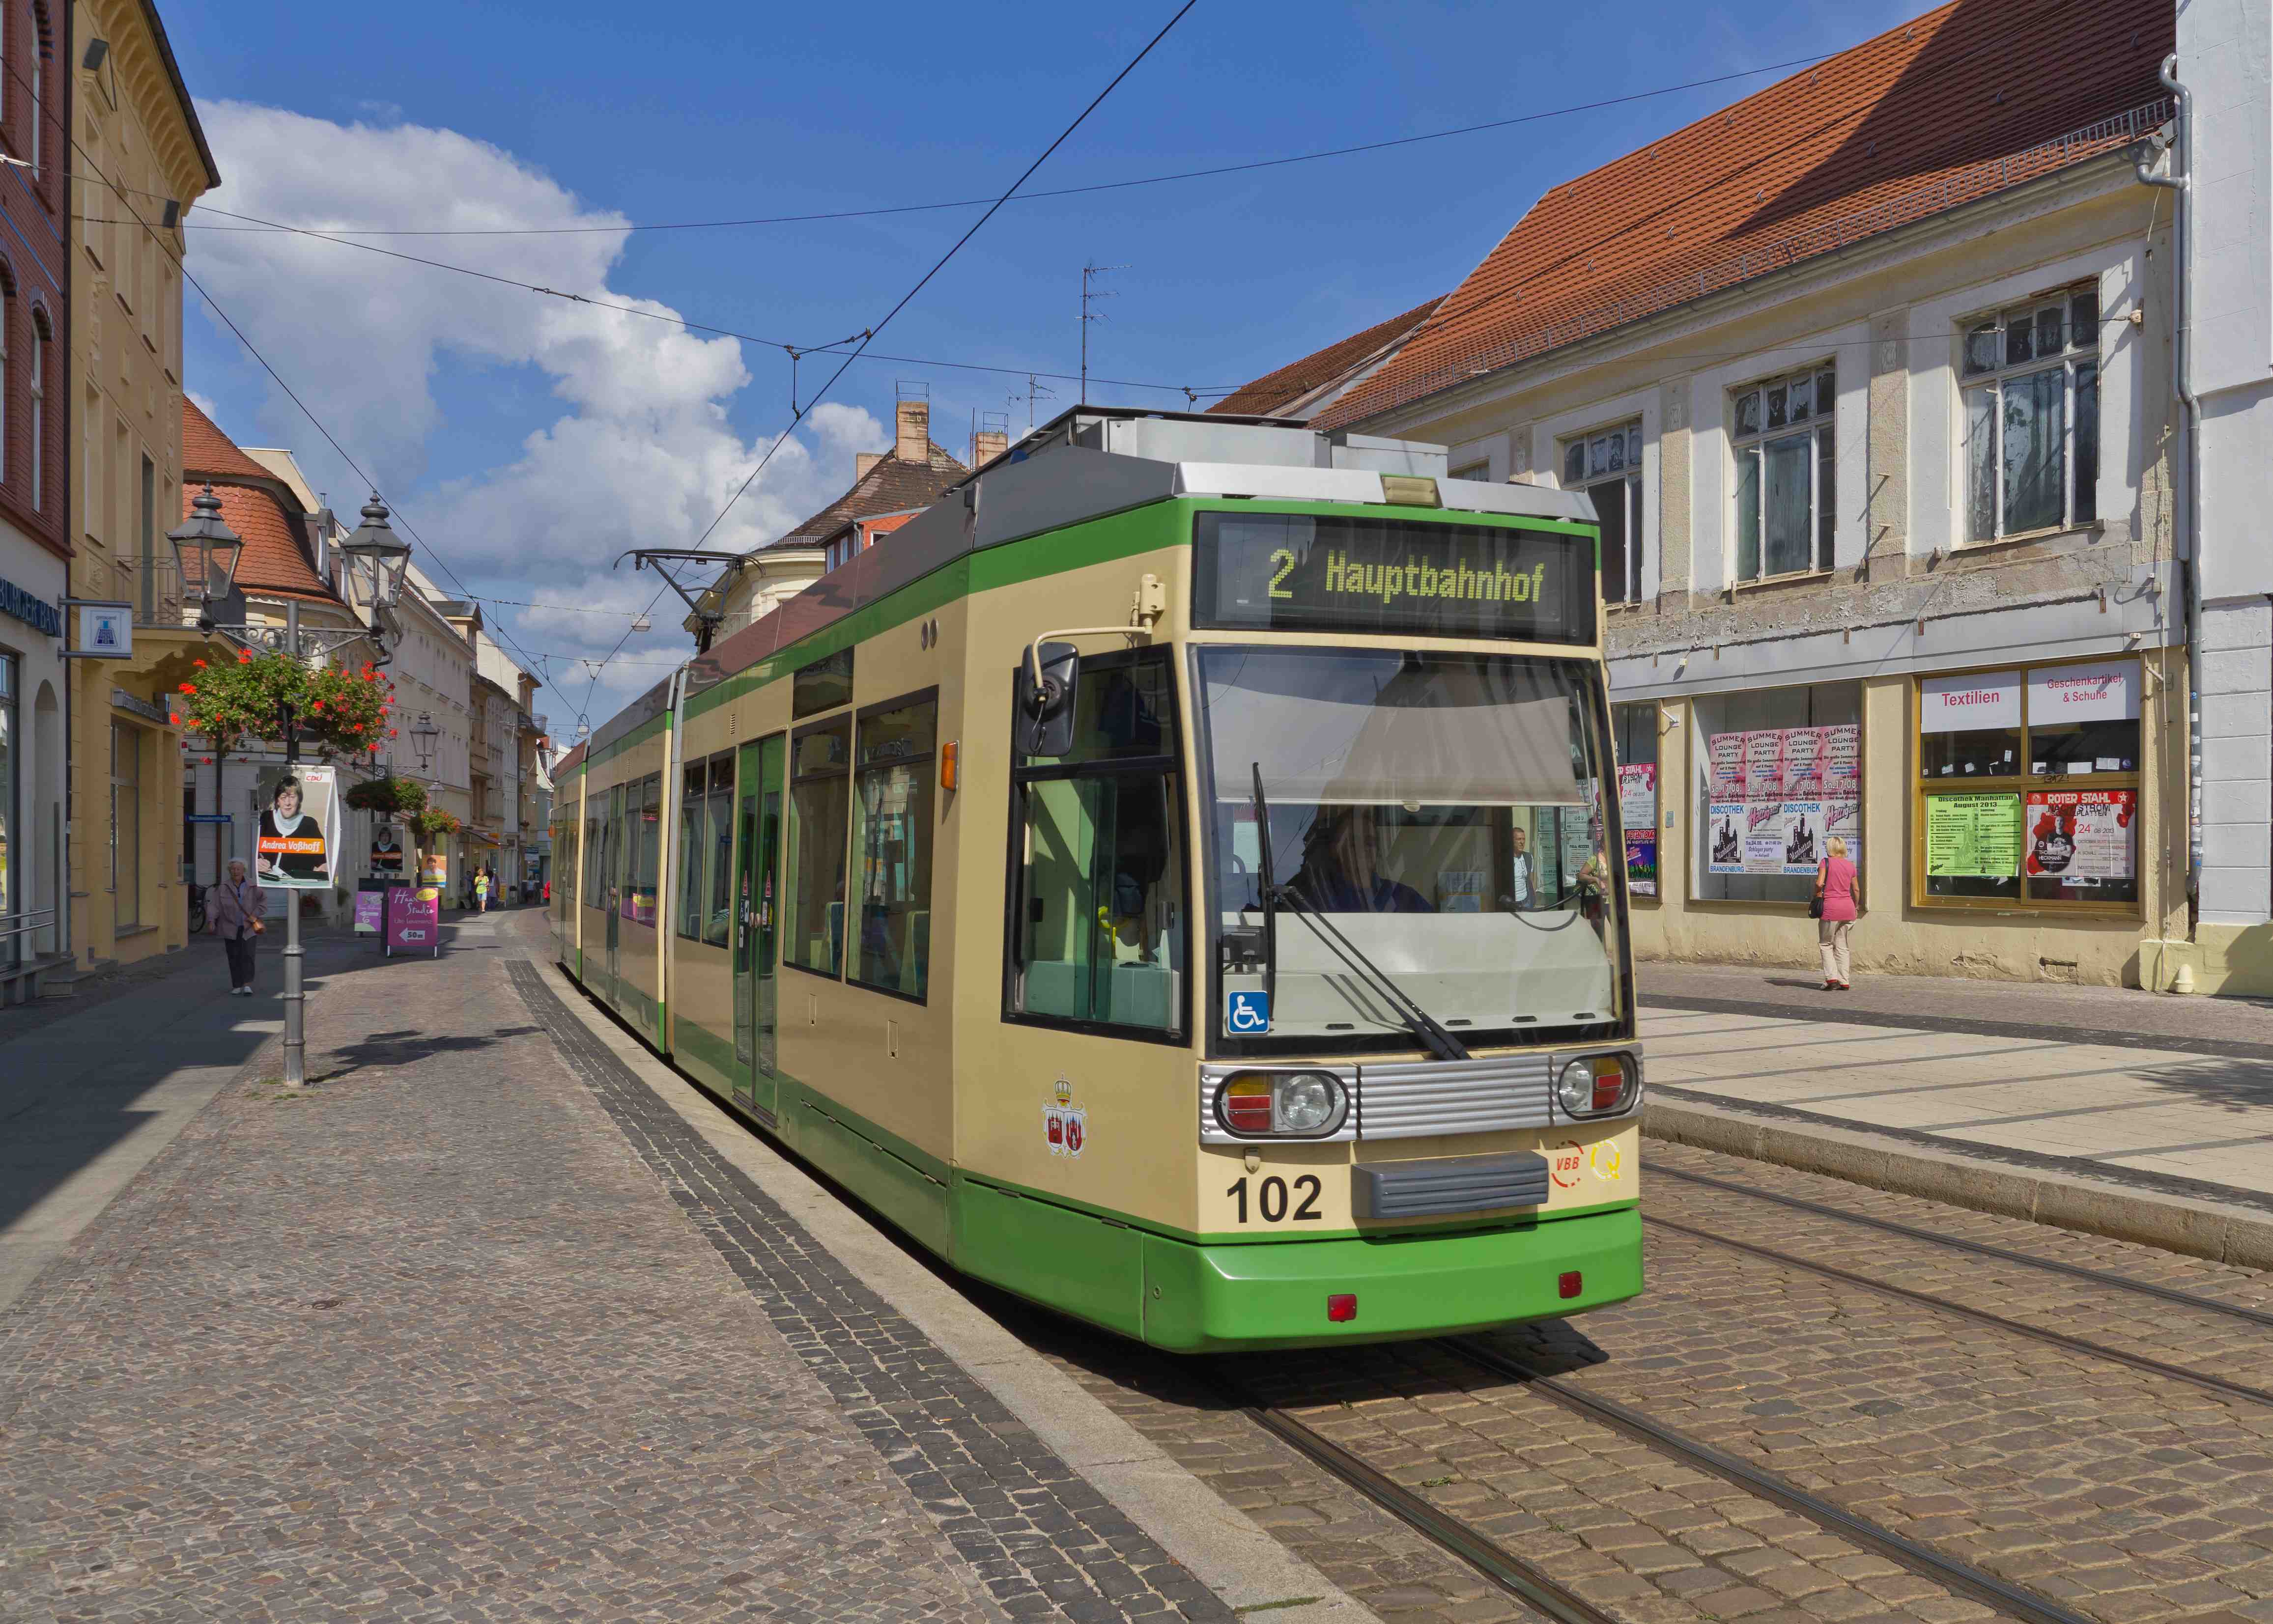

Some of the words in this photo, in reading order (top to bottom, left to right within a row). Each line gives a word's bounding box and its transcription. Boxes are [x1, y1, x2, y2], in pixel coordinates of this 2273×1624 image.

[1268, 549, 1295, 598] 2
[1326, 549, 1545, 604] Hauptbahnhof
[2047, 673, 2121, 689] Geschenkartikel
[1942, 690, 1999, 706] Textilien
[2063, 693, 2070, 702] &
[2073, 691, 2107, 702] Schuhe
[1747, 733, 1782, 743] SUMMER
[1785, 730, 1821, 741] SUMMER
[1824, 728, 1861, 738] SUMMER
[1711, 736, 1745, 746] SUMMER
[1625, 765, 1643, 775] STAHL
[2048, 793, 2077, 804] ROTER
[2081, 793, 2110, 803] STAHL
[1710, 805, 1744, 814] DISCOTHEK
[1784, 803, 1820, 812] DISCOTHEK
[2078, 824, 2090, 833] 24
[261, 840, 286, 849] Andrea
[288, 841, 320, 852] Voßhoff
[406, 902, 434, 916] Studio
[1557, 1156, 1579, 1171] VBB
[1226, 1175, 1322, 1223] 102
